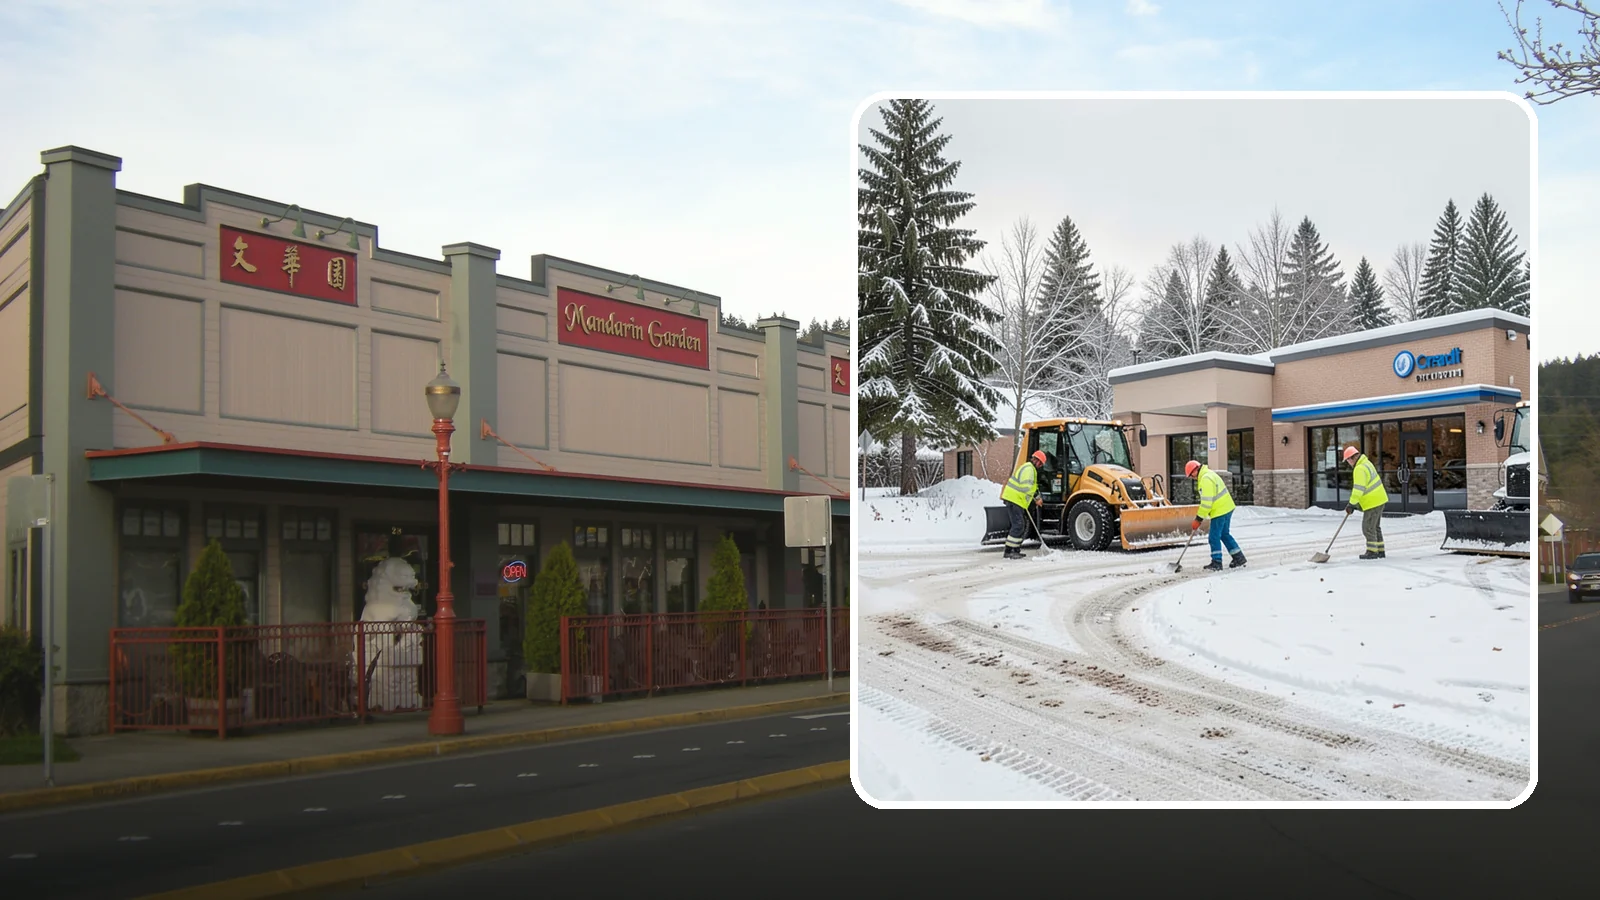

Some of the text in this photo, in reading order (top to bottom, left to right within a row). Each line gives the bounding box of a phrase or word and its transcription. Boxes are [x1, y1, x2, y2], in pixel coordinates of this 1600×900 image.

[231, 235, 346, 290] 文華園
[564, 302, 701, 352] Mandarin Garden
[503, 565, 527, 578] OPEN
